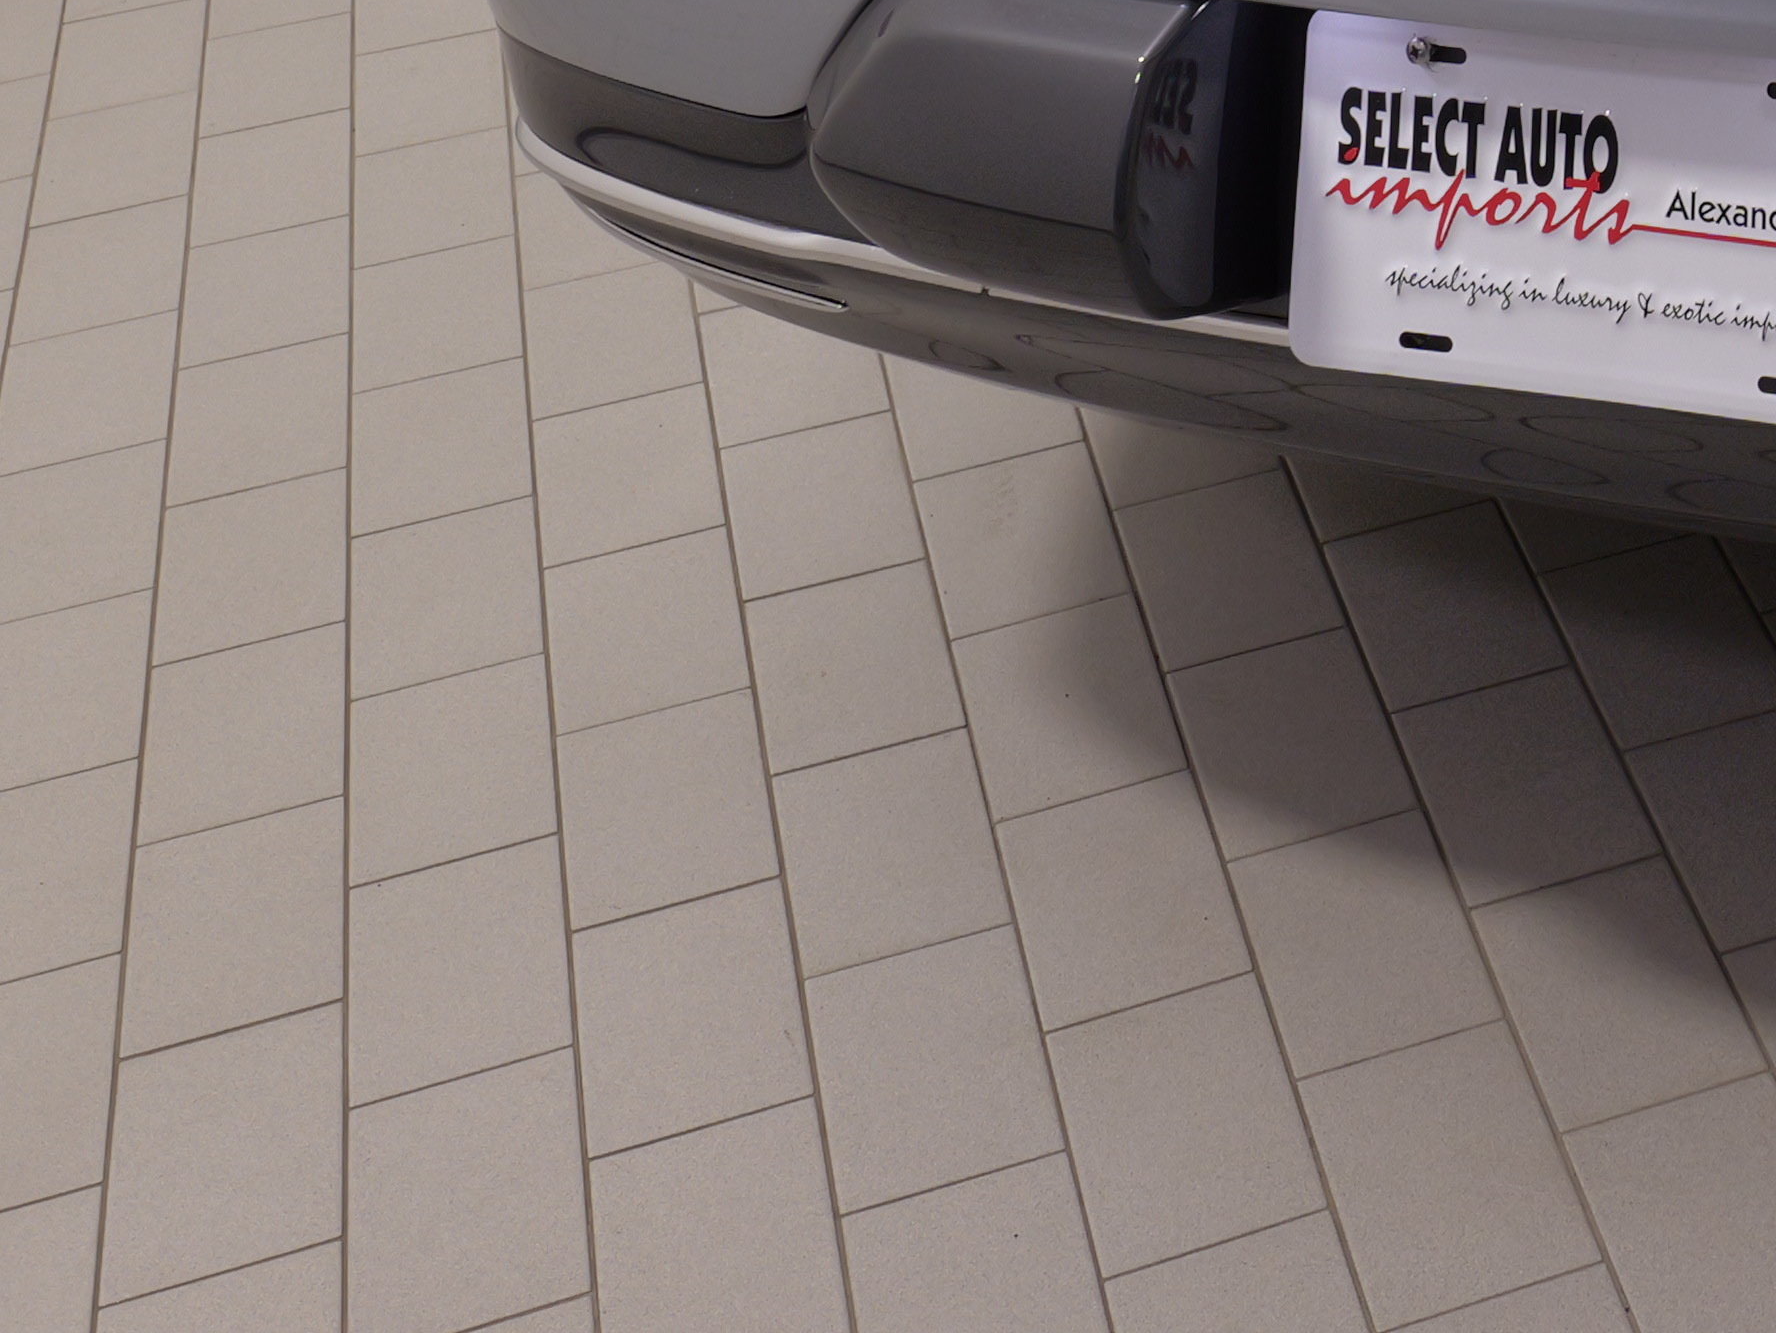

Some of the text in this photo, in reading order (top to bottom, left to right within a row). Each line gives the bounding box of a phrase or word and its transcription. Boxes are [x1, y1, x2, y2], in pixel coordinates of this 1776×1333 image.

[1337, 87, 1619, 194] SELECT AUTO
[1325, 170, 1631, 250] imports
[1385, 265, 1514, 311] specializing
[1518, 277, 1548, 302] in
[1552, 277, 1632, 324] luxury
[1637, 292, 1655, 318] &
[1661, 299, 1727, 326] exotic
